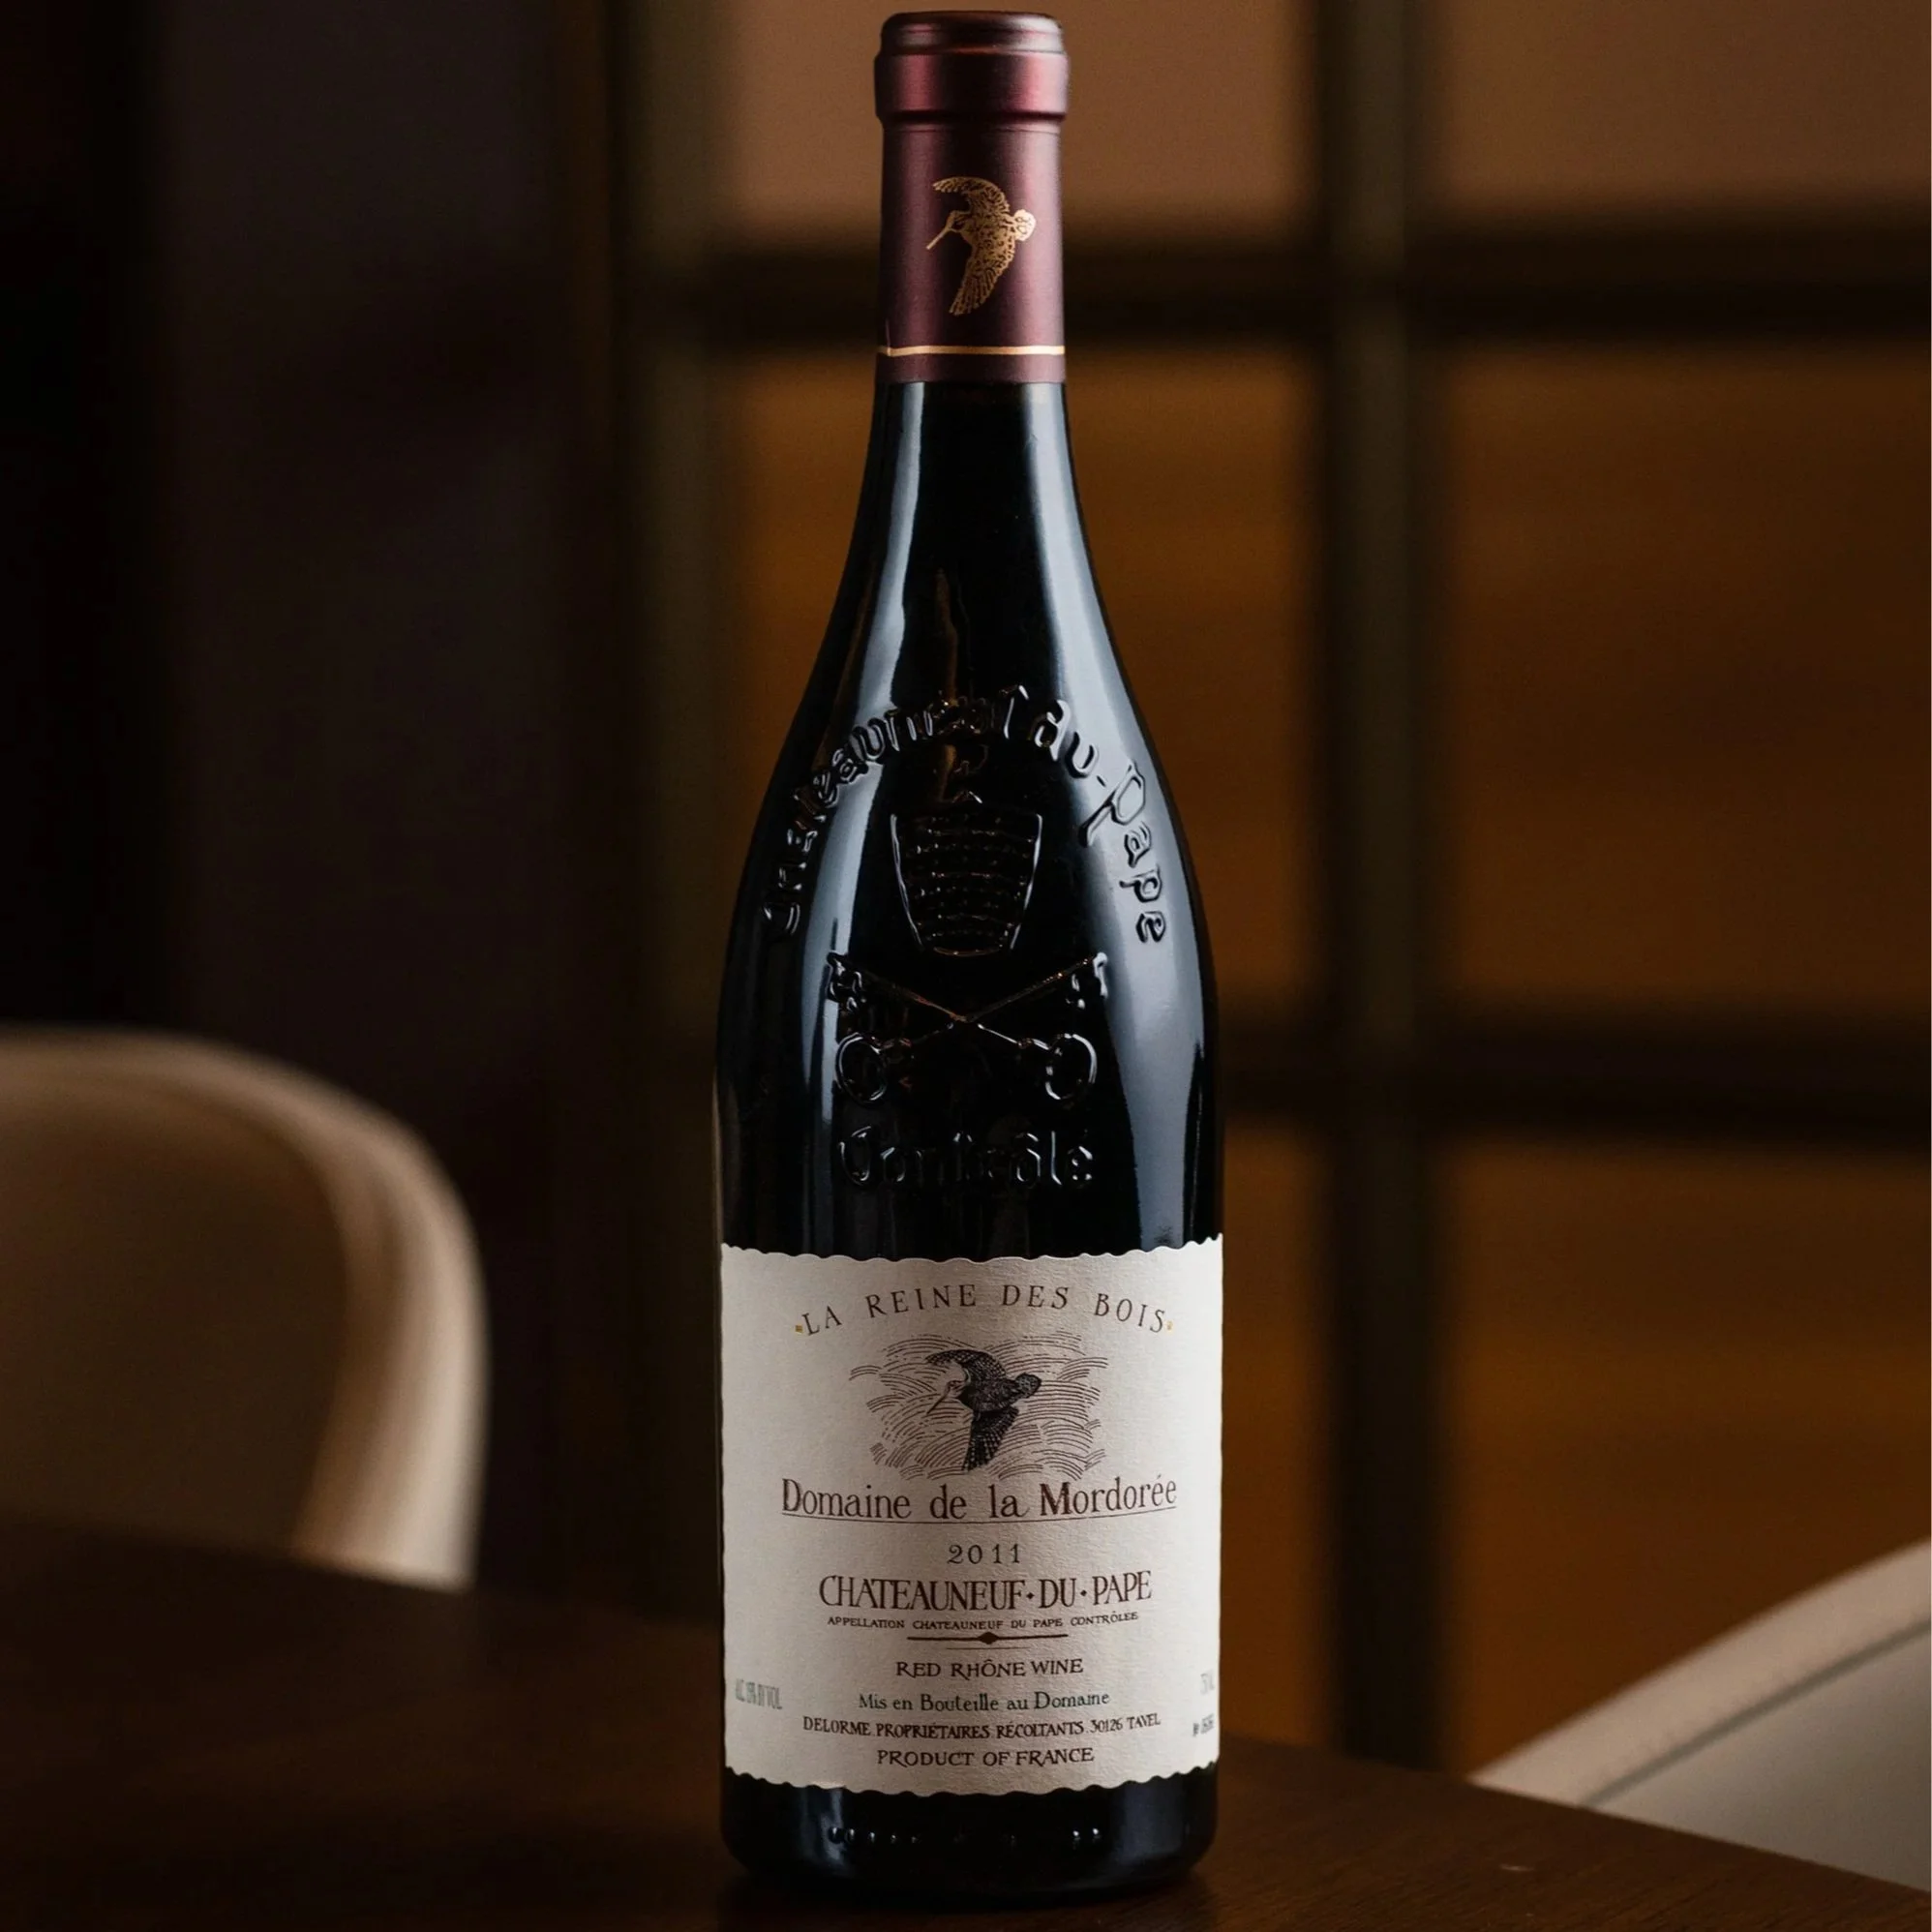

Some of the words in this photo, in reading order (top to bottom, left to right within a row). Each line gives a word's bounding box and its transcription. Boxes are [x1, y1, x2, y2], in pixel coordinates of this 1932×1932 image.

[801, 1305, 842, 1336] LA
[866, 1283, 977, 1319] REINE
[1002, 1284, 1069, 1309] DES
[1095, 1292, 1164, 1334] BOIS
[781, 1478, 912, 1519] Domaine
[929, 1484, 967, 1519] de
[988, 1484, 1030, 1518] la
[1040, 1475, 1177, 1517] Mordorée
[948, 1544, 1020, 1565] 2011
[828, 1615, 904, 1630] APPELLATION
[913, 1620, 1003, 1630] CHATEAUNEUF
[1011, 1619, 1026, 1629] DU
[1033, 1617, 1062, 1628] PAPE
[895, 1661, 942, 1678] RED
[951, 1659, 1026, 1680] RHÔNE
[1031, 1658, 1084, 1675] WINE
[859, 1694, 888, 1709] Mis
[892, 1699, 914, 1710] en
[921, 1693, 999, 1711] Bouteille
[1007, 1699, 1029, 1710] au
[1034, 1692, 1111, 1709] Domaine
[1090, 1718, 1124, 1734] 30126
[1127, 1712, 1162, 1730] TAVEL
[877, 1749, 976, 1767] PRODUCT
[982, 1751, 1011, 1766] OF
[1016, 1747, 1095, 1767] FRANCE
